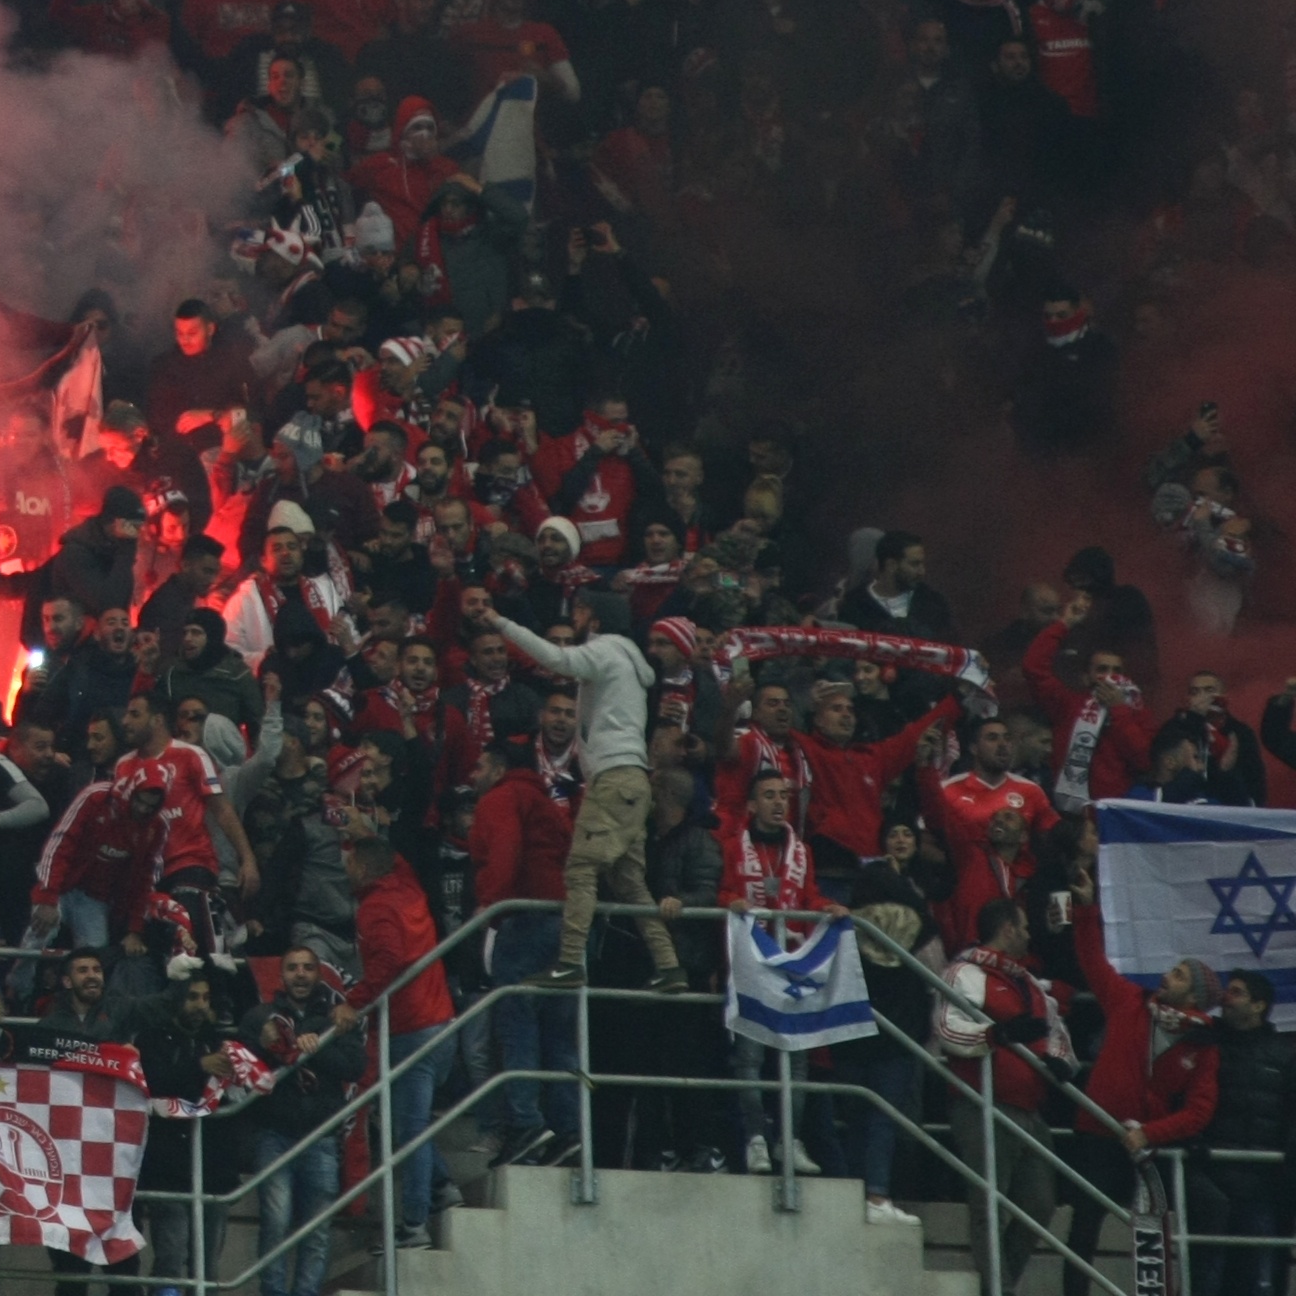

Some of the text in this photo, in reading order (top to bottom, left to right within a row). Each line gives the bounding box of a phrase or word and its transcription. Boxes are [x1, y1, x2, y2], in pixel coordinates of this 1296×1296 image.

[56, 1038, 101, 1055] HAPOEL
[29, 1047, 121, 1072] BEER-SHEVA FC
